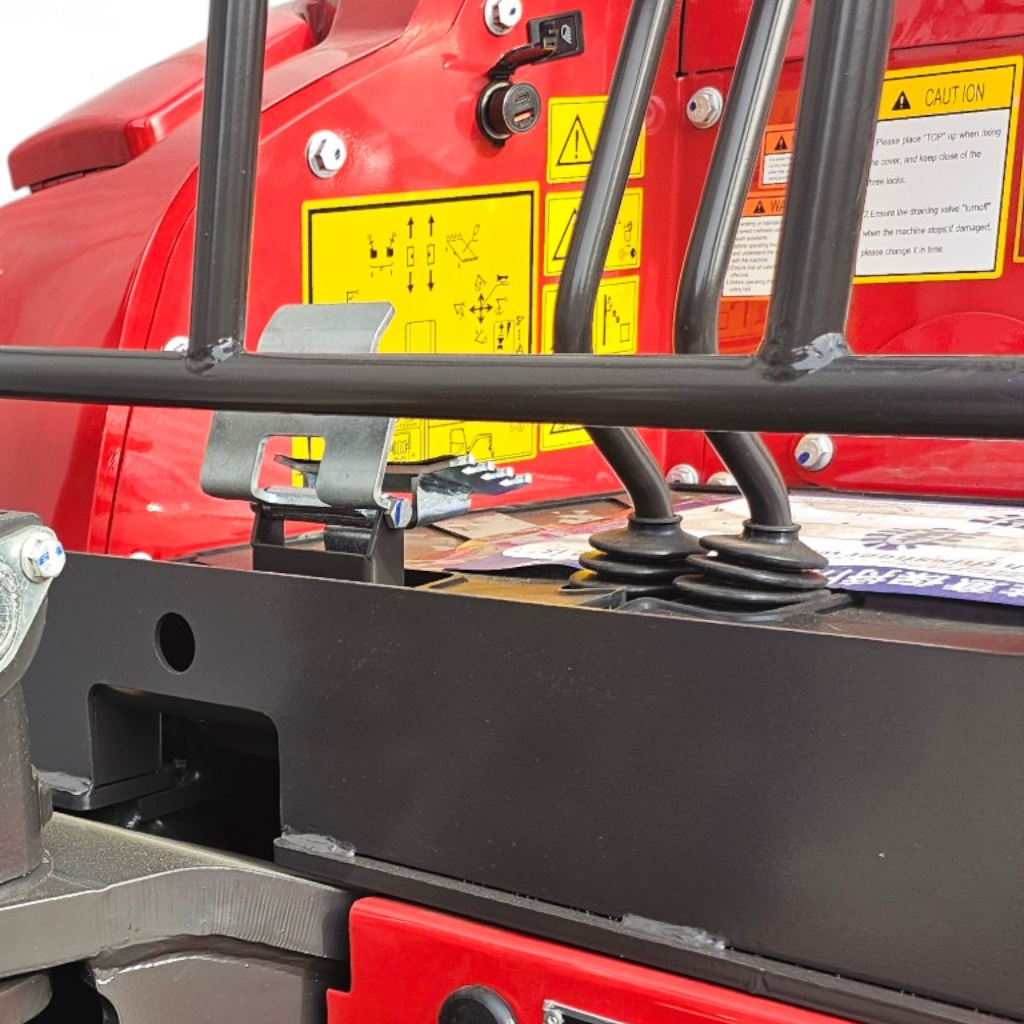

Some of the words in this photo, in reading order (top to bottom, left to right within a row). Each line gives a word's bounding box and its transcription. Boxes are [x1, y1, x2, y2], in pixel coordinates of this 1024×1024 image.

[901, 135, 921, 146] place
[947, 133, 957, 142] up
[959, 130, 980, 140] when
[904, 154, 918, 164] and
[960, 150, 969, 160] of
[863, 227, 881, 238] when
[882, 227, 894, 237] the
[896, 225, 925, 236] machine
